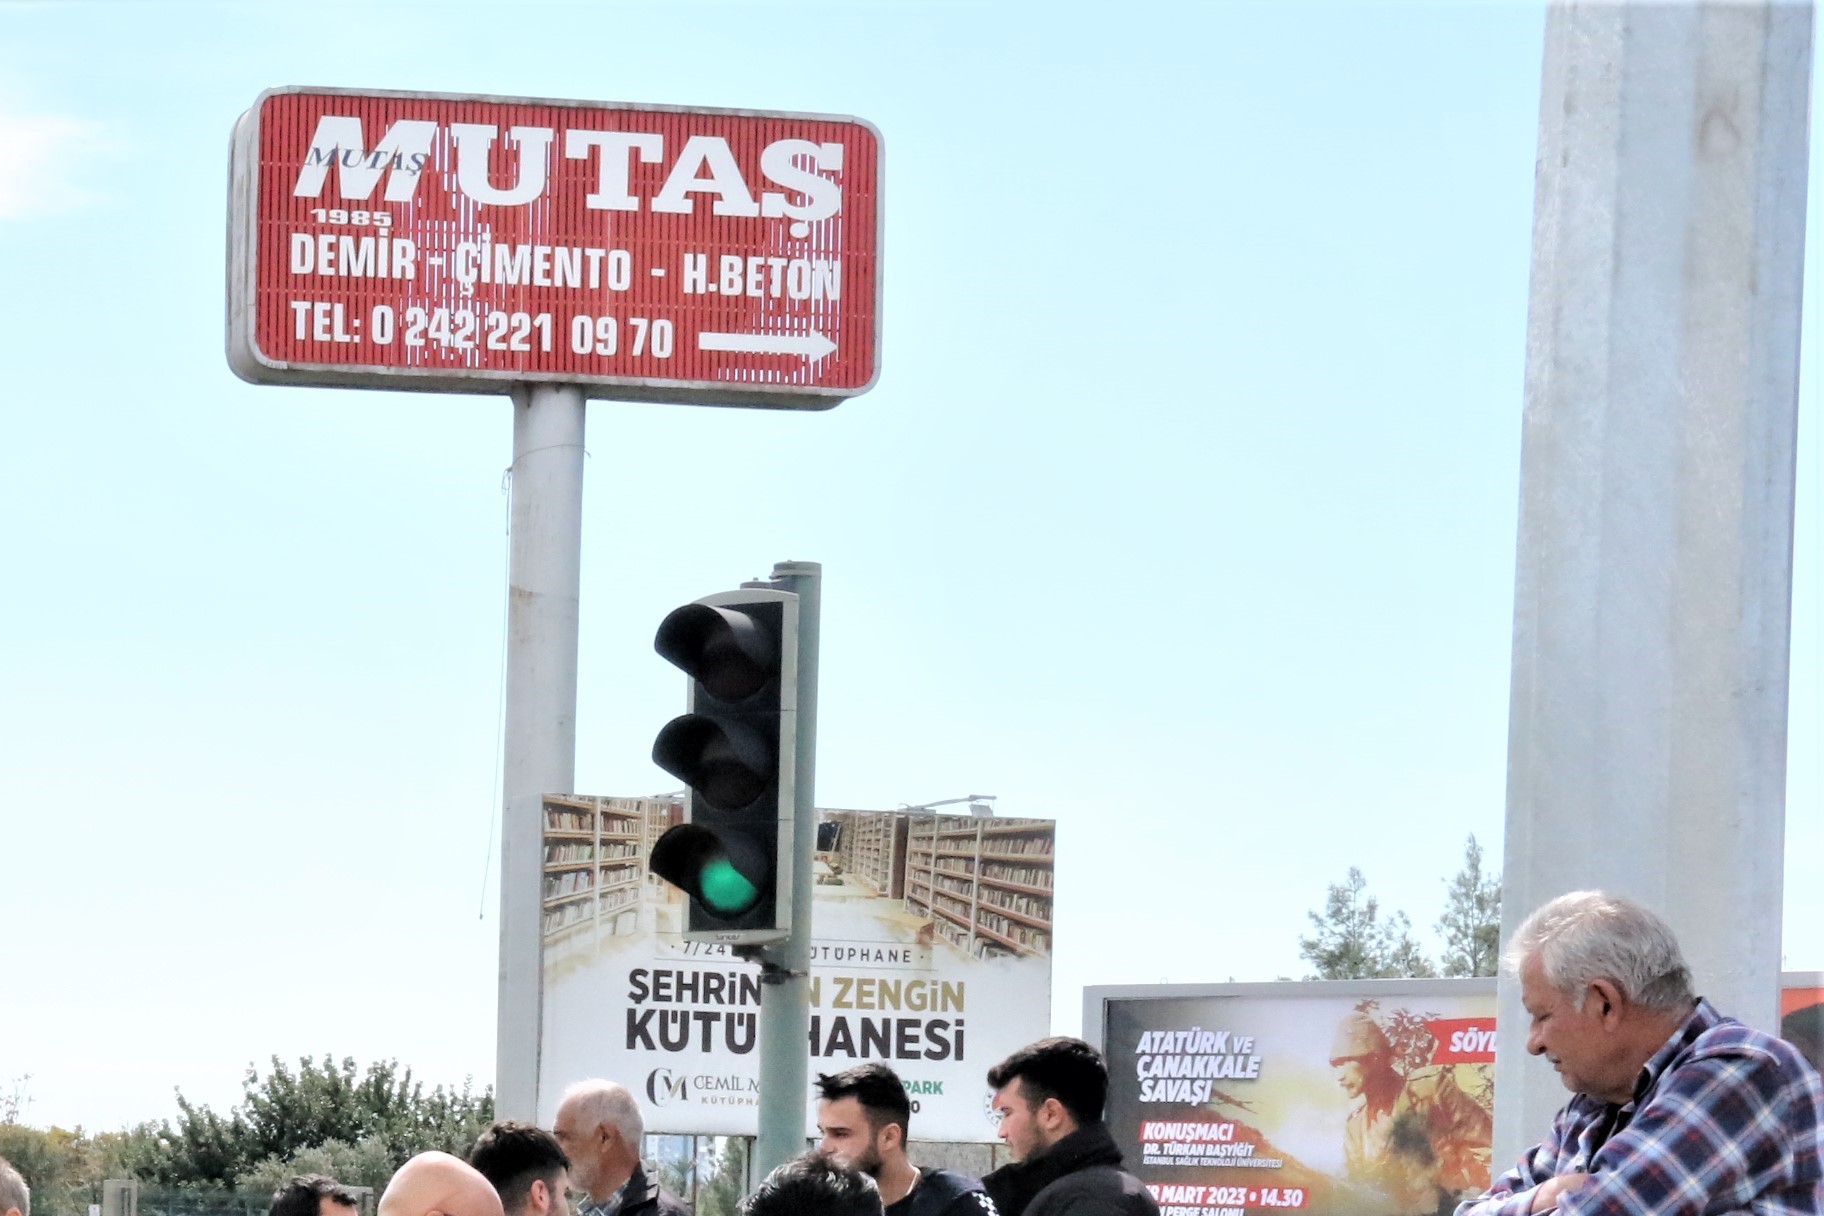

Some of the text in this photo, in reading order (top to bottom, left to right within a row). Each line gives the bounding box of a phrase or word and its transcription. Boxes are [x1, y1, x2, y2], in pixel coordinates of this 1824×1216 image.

[305, 147, 429, 176] MUTAŞ
[293, 115, 844, 238] MUTAŞ
[310, 208, 393, 227] 1985
[291, 227, 416, 280] DEMİR
[456, 232, 631, 296] ÇİMENTO
[684, 253, 841, 301] H.BETON
[291, 301, 673, 358] TEL: 0 242 221 09 70
[683, 940, 912, 963] 7/24 ÜTÜPHANE
[832, 977, 965, 1012] ZENGİN
[1135, 1027, 1254, 1053] ATATÜRK VE
[1449, 1027, 1496, 1052] SÖYL
[1137, 1056, 1261, 1081] ÇANAKKALE
[694, 1074, 744, 1091] CEMİL
[1139, 1079, 1214, 1106] SAVAŞI
[1143, 1122, 1235, 1142] KONUŞMACI
[1143, 1141, 1255, 1157] DR. TÜRKAN BAŞYİĞİT
[1160, 1186, 1207, 1204] MART
[1207, 1187, 1247, 1206] 2023
[1260, 1188, 1303, 1207] 14.30
